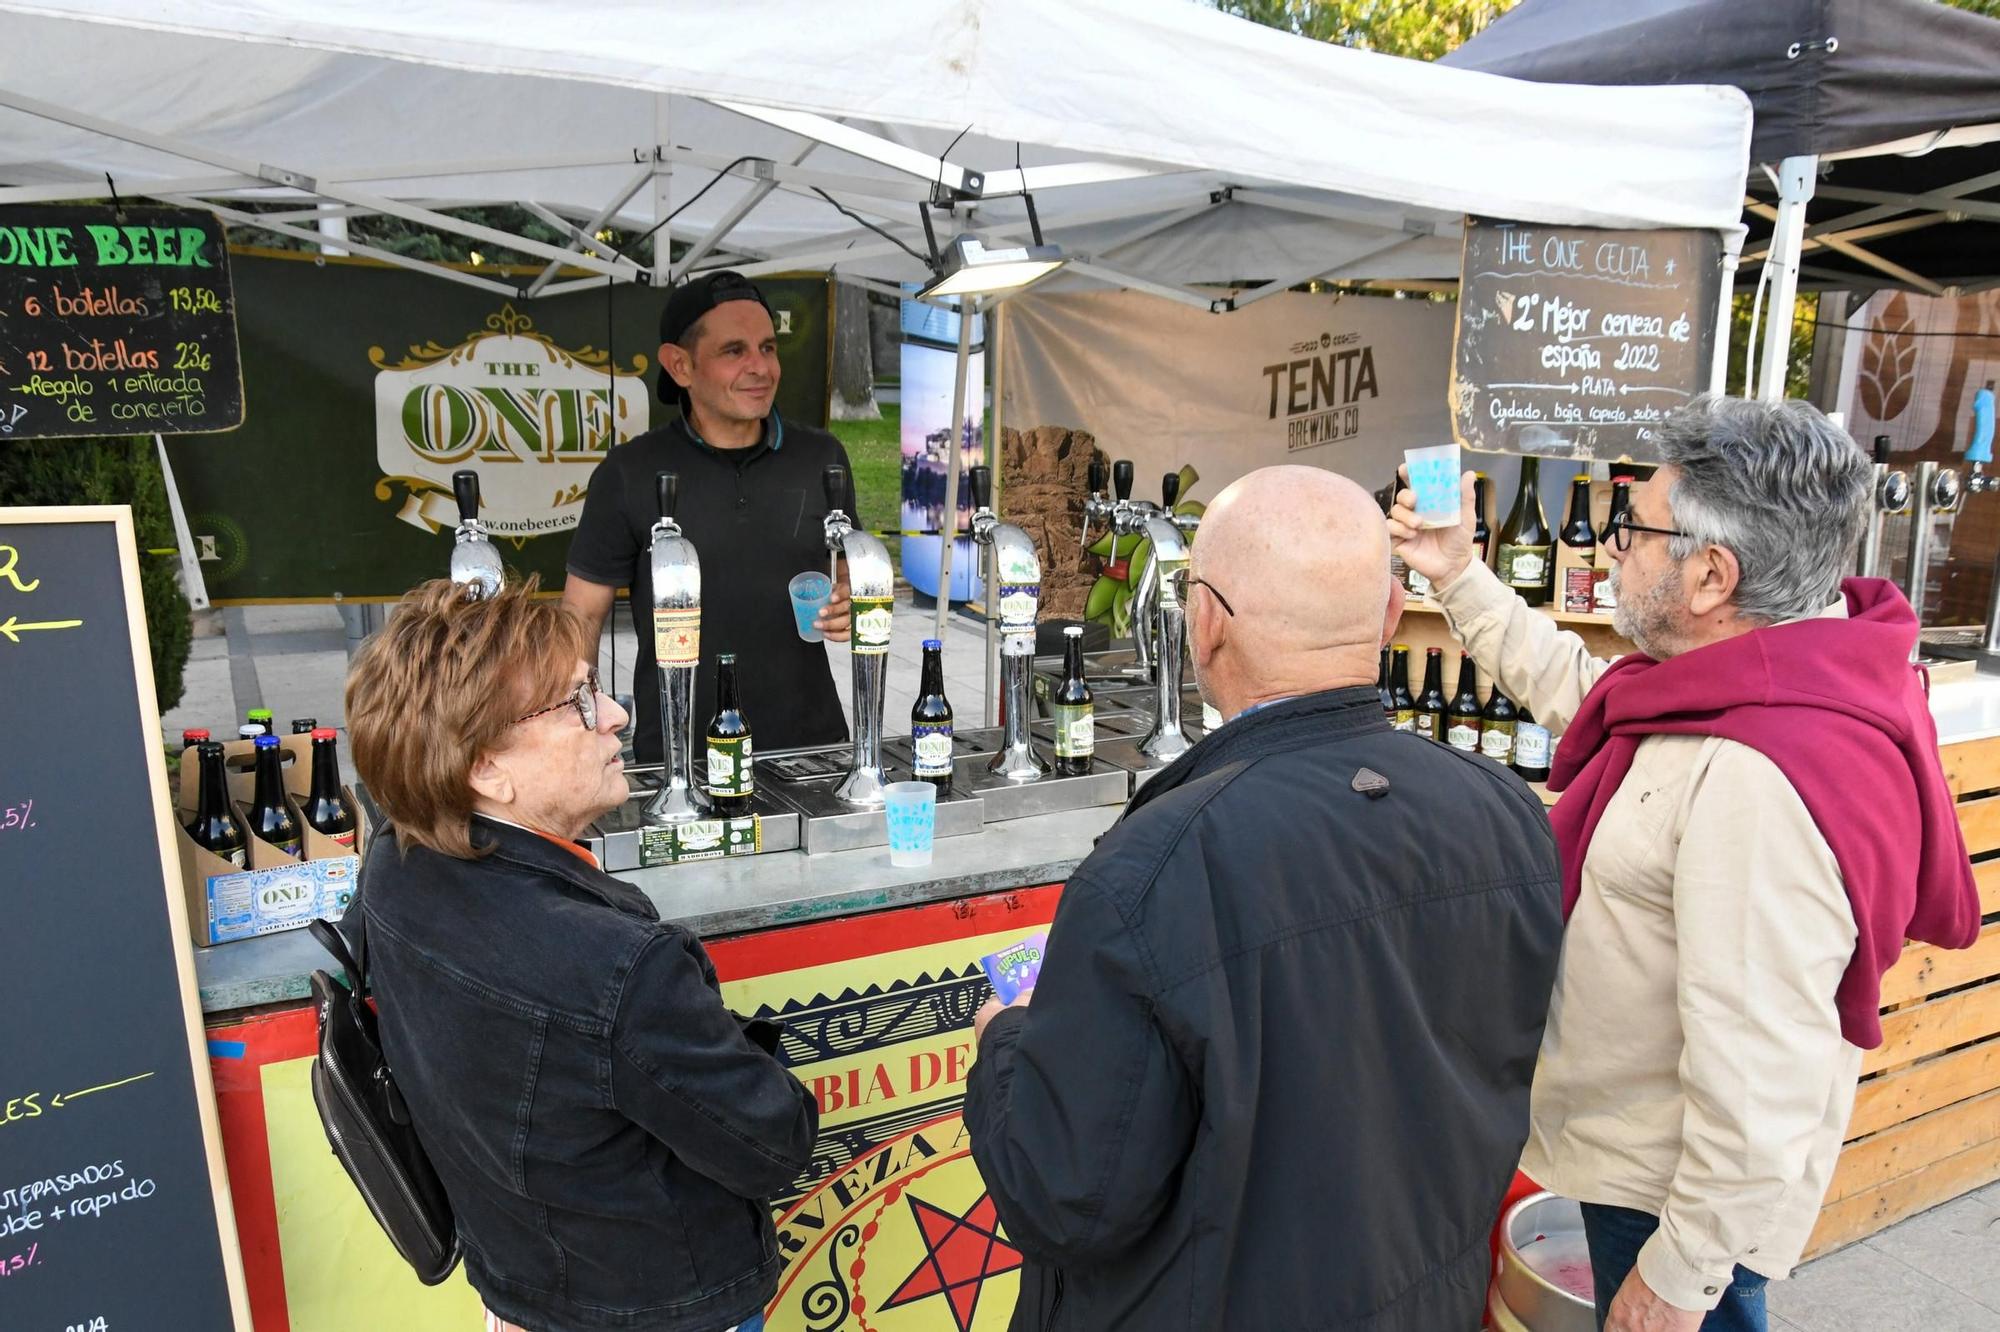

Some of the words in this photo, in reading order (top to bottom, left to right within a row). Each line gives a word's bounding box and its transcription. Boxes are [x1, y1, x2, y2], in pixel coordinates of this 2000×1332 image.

[0, 226, 78, 267] ONE
[85, 224, 213, 268] BEER
[1495, 223, 1535, 265] THE
[1543, 236, 1584, 271] ONE
[1595, 241, 1650, 279] CELTA
[25, 296, 41, 316] 6
[53, 286, 149, 317] botellas
[169, 286, 222, 316] 13,50€
[1542, 296, 1591, 343] Mejor
[1602, 313, 1664, 338] cerveza
[1669, 312, 1690, 343] de
[27, 351, 53, 371] 12
[62, 339, 159, 372] botellas
[173, 342, 211, 371] 23€
[484, 361, 540, 376] THE
[1541, 343, 1601, 378] españa
[1613, 341, 1660, 372] 2022
[30, 374, 94, 405] Regalo
[107, 377, 118, 394] 1
[124, 371, 202, 394] entrada
[1262, 345, 1379, 420] TENTA
[1581, 375, 1616, 397] PLATA
[67, 401, 97, 423] de
[111, 395, 206, 419] concierto
[402, 383, 628, 464] ONE
[1633, 404, 1661, 421] sube
[1287, 411, 1339, 449] BREWING
[1343, 407, 1359, 436] CO
[480, 513, 577, 531] w.onebeer.es
[682, 821, 721, 838] ONE
[263, 883, 308, 905] ONE
[801, 1062, 899, 1115] BIA
[908, 1043, 970, 1095] DE
[0, 1092, 42, 1125] ES
[70, 1178, 156, 1217] rapido
